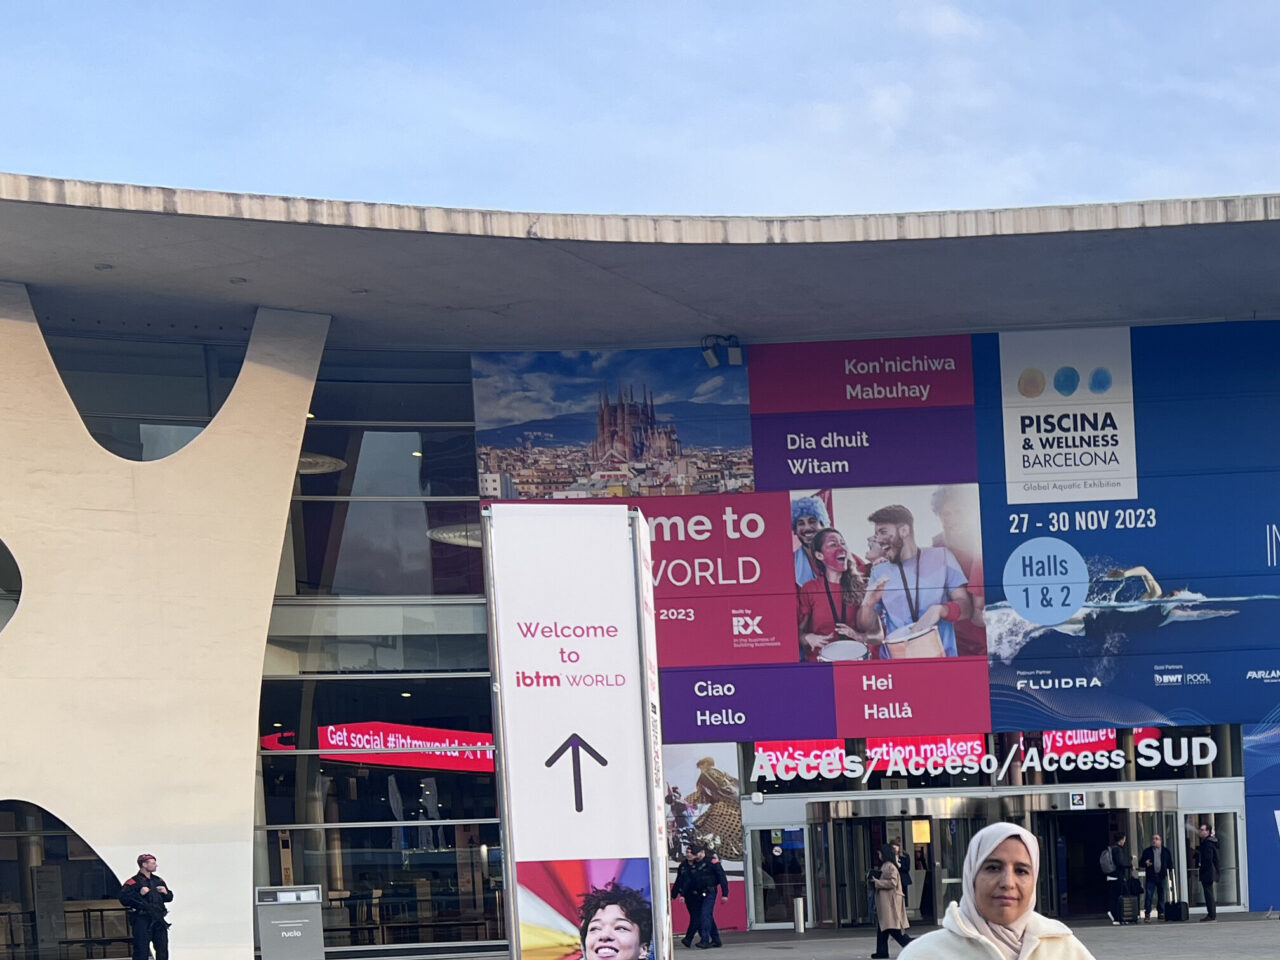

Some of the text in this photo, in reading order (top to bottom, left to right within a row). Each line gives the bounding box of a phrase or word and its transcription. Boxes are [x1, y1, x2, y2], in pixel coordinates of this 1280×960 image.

[844, 355, 956, 375] Kon'nichiwa
[846, 381, 931, 401] Mabuhay
[1020, 412, 1118, 434] PISCINA
[787, 431, 870, 450] Dia dhuit
[1022, 434, 1119, 450] & WELLNESS
[787, 458, 849, 475] Witam
[1022, 451, 1120, 469] BARCELONA
[1023, 479, 1121, 492] Global Aquatic Exhibition
[648, 506, 765, 541] me to
[1009, 513, 1029, 534] 27
[1049, 512, 1070, 532] 30
[1075, 510, 1109, 531] NOV
[1115, 508, 1156, 529] 2023
[1022, 555, 1069, 578] Halls
[1022, 586, 1071, 609] 1 & 2
[660, 608, 695, 621] 2023
[516, 622, 618, 638] Welcome
[732, 616, 763, 635] RX
[559, 648, 580, 663] to
[516, 671, 626, 687] ibtm WORLD
[862, 674, 893, 691] Hei
[1016, 676, 1102, 690] FLUIDRA
[1162, 674, 1182, 683] BWT
[1187, 673, 1210, 682] POOL
[694, 681, 735, 697] Ciao
[696, 709, 746, 726] Hello
[864, 702, 913, 720] Hallå
[327, 726, 348, 746] Get
[350, 730, 384, 748] social
[920, 738, 982, 759] makers
[1136, 736, 1218, 768] SUD
